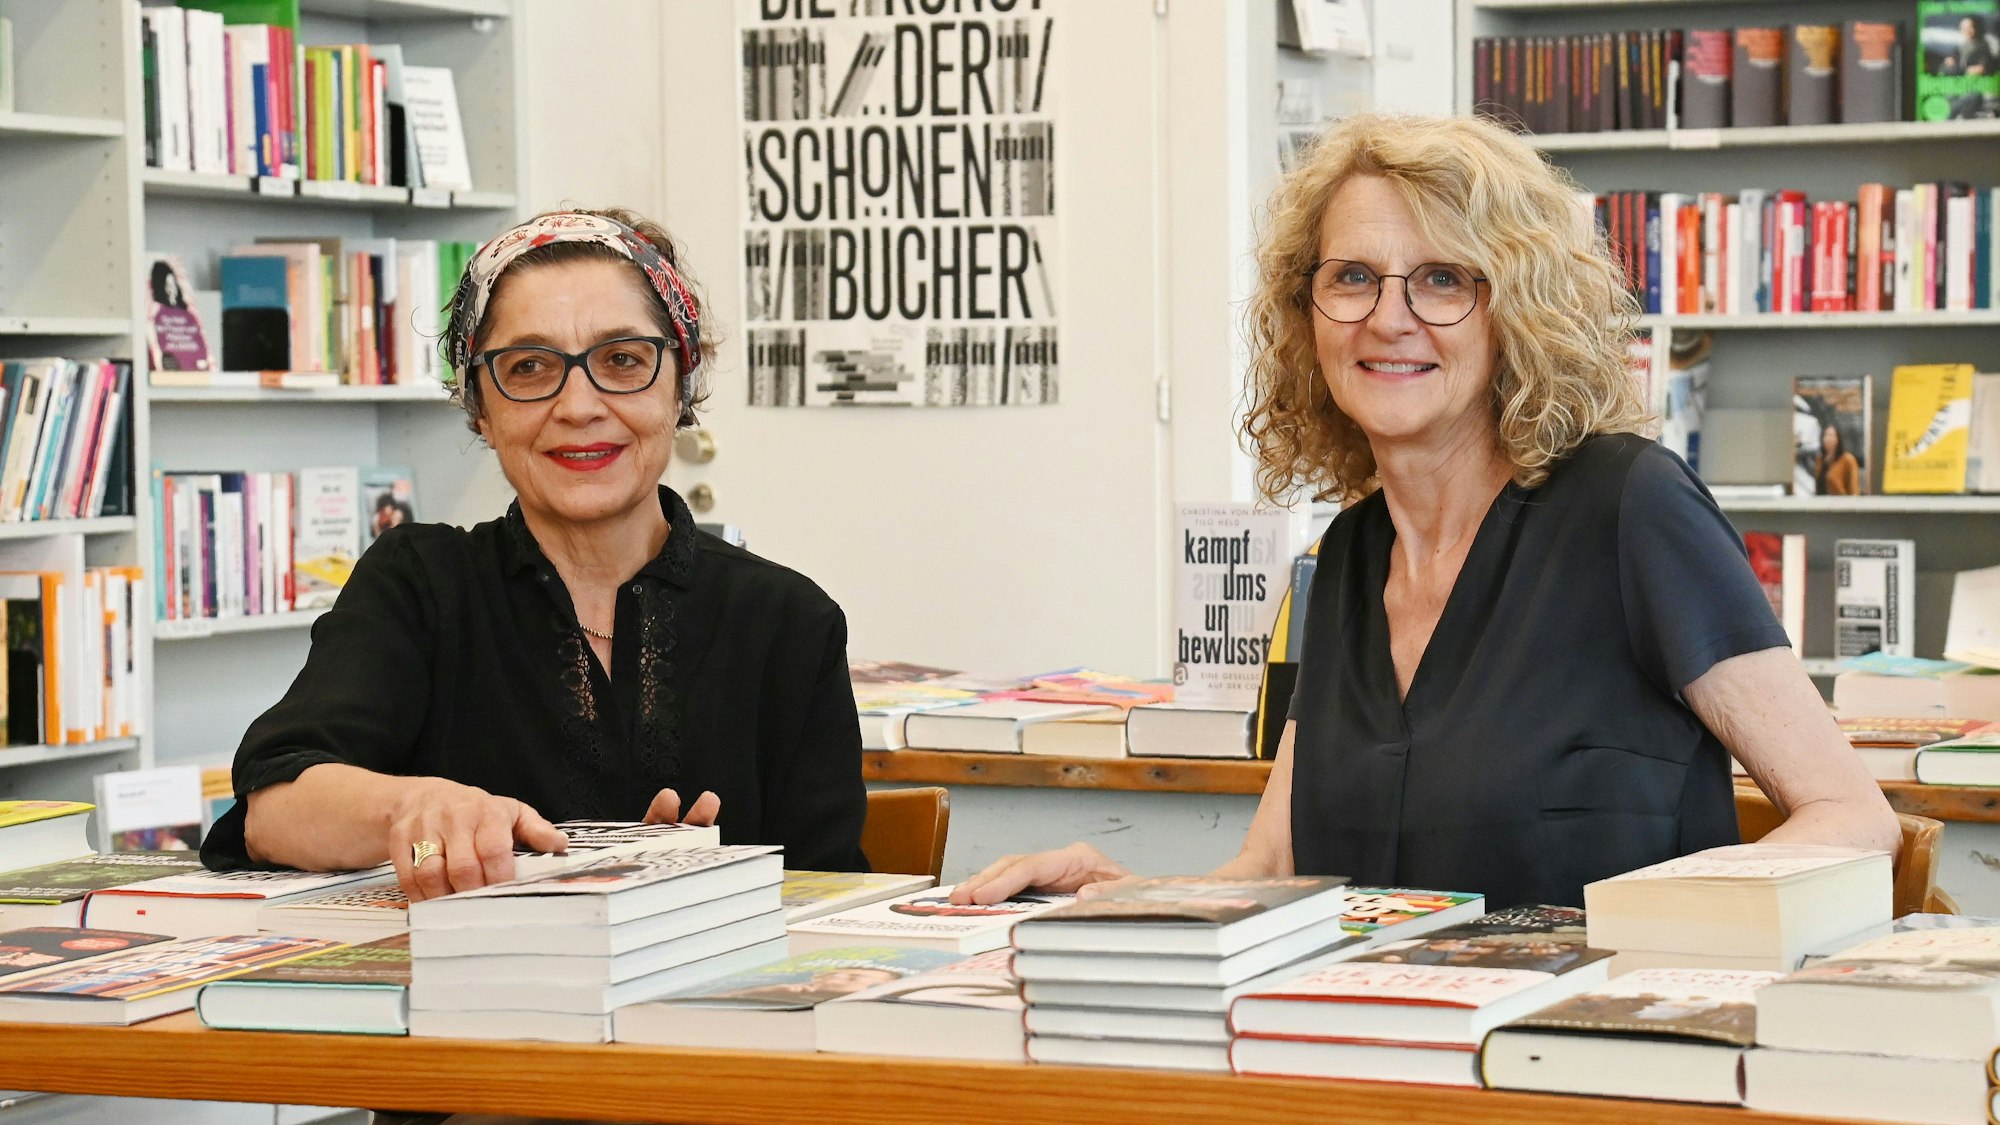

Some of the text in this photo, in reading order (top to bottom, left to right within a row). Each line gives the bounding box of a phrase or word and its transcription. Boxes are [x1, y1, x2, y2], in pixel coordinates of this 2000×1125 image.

[894, 20, 994, 118] DER
[758, 104, 993, 222] SCHÖNEN
[828, 206, 1032, 321] BÜCHER
[1182, 507, 1281, 516] CHRISTINA VON BRAUN
[1195, 518, 1214, 526] TILO
[1185, 528, 1250, 570] kampf
[1223, 573, 1266, 602] ums
[1205, 604, 1229, 632] un
[1178, 628, 1270, 666] bewusst
[1200, 672, 1219, 680] EINE
